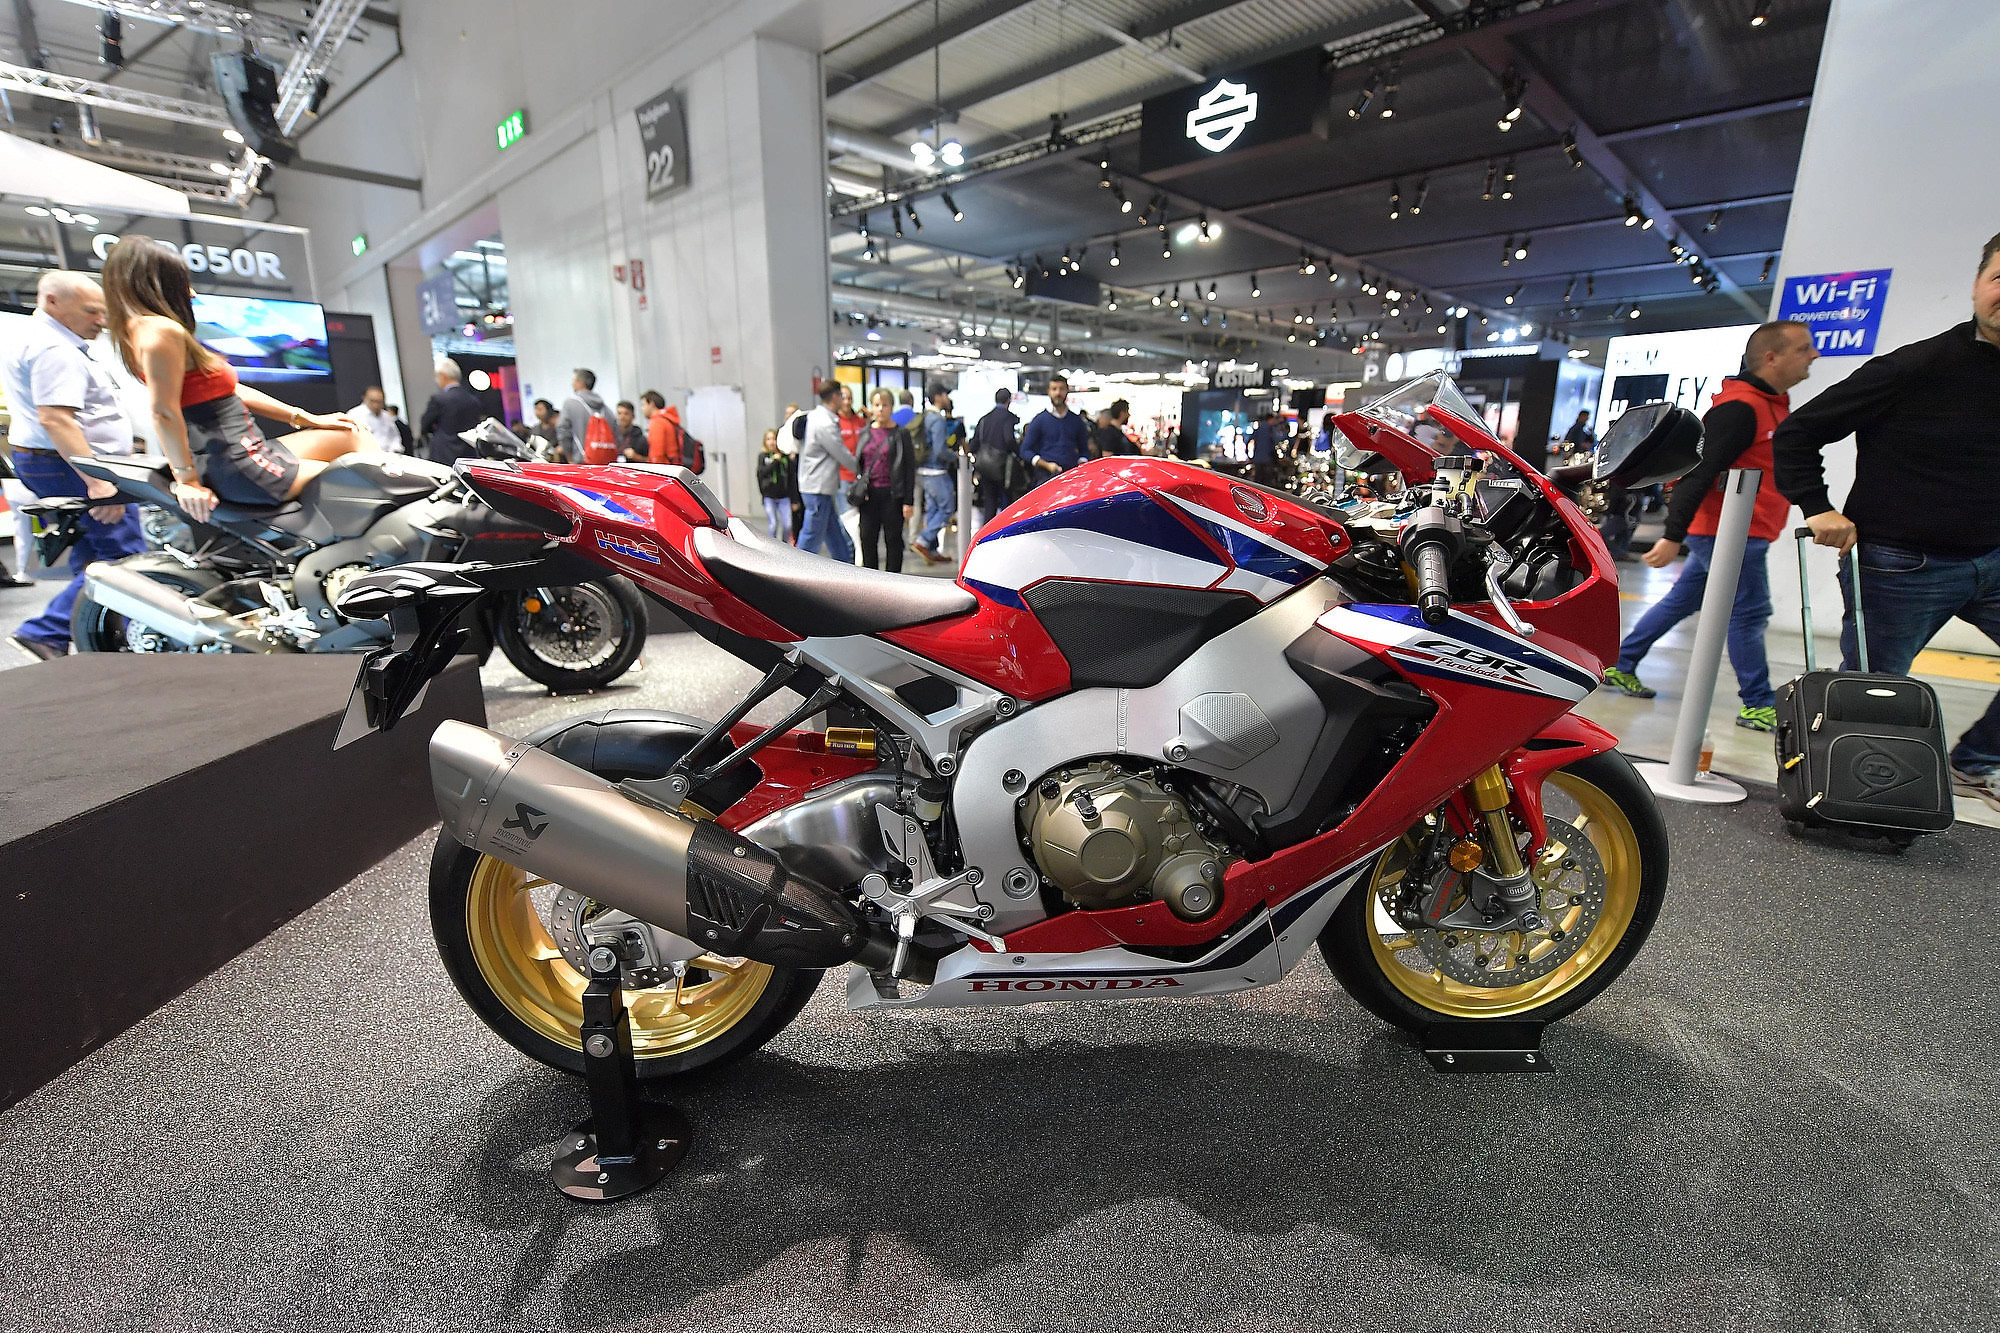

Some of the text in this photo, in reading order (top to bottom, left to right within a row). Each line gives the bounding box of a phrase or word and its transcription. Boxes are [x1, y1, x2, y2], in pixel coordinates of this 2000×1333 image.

[648, 145, 674, 192] 22
[1796, 278, 1877, 305] Wi-Fi
[1851, 306, 1870, 321] by
[1815, 328, 1866, 350] TIM
[594, 529, 661, 565] HRC
[1414, 640, 1530, 682] CBR
[1434, 656, 1502, 680] Fireblade
[968, 977, 1185, 992] HONDA
